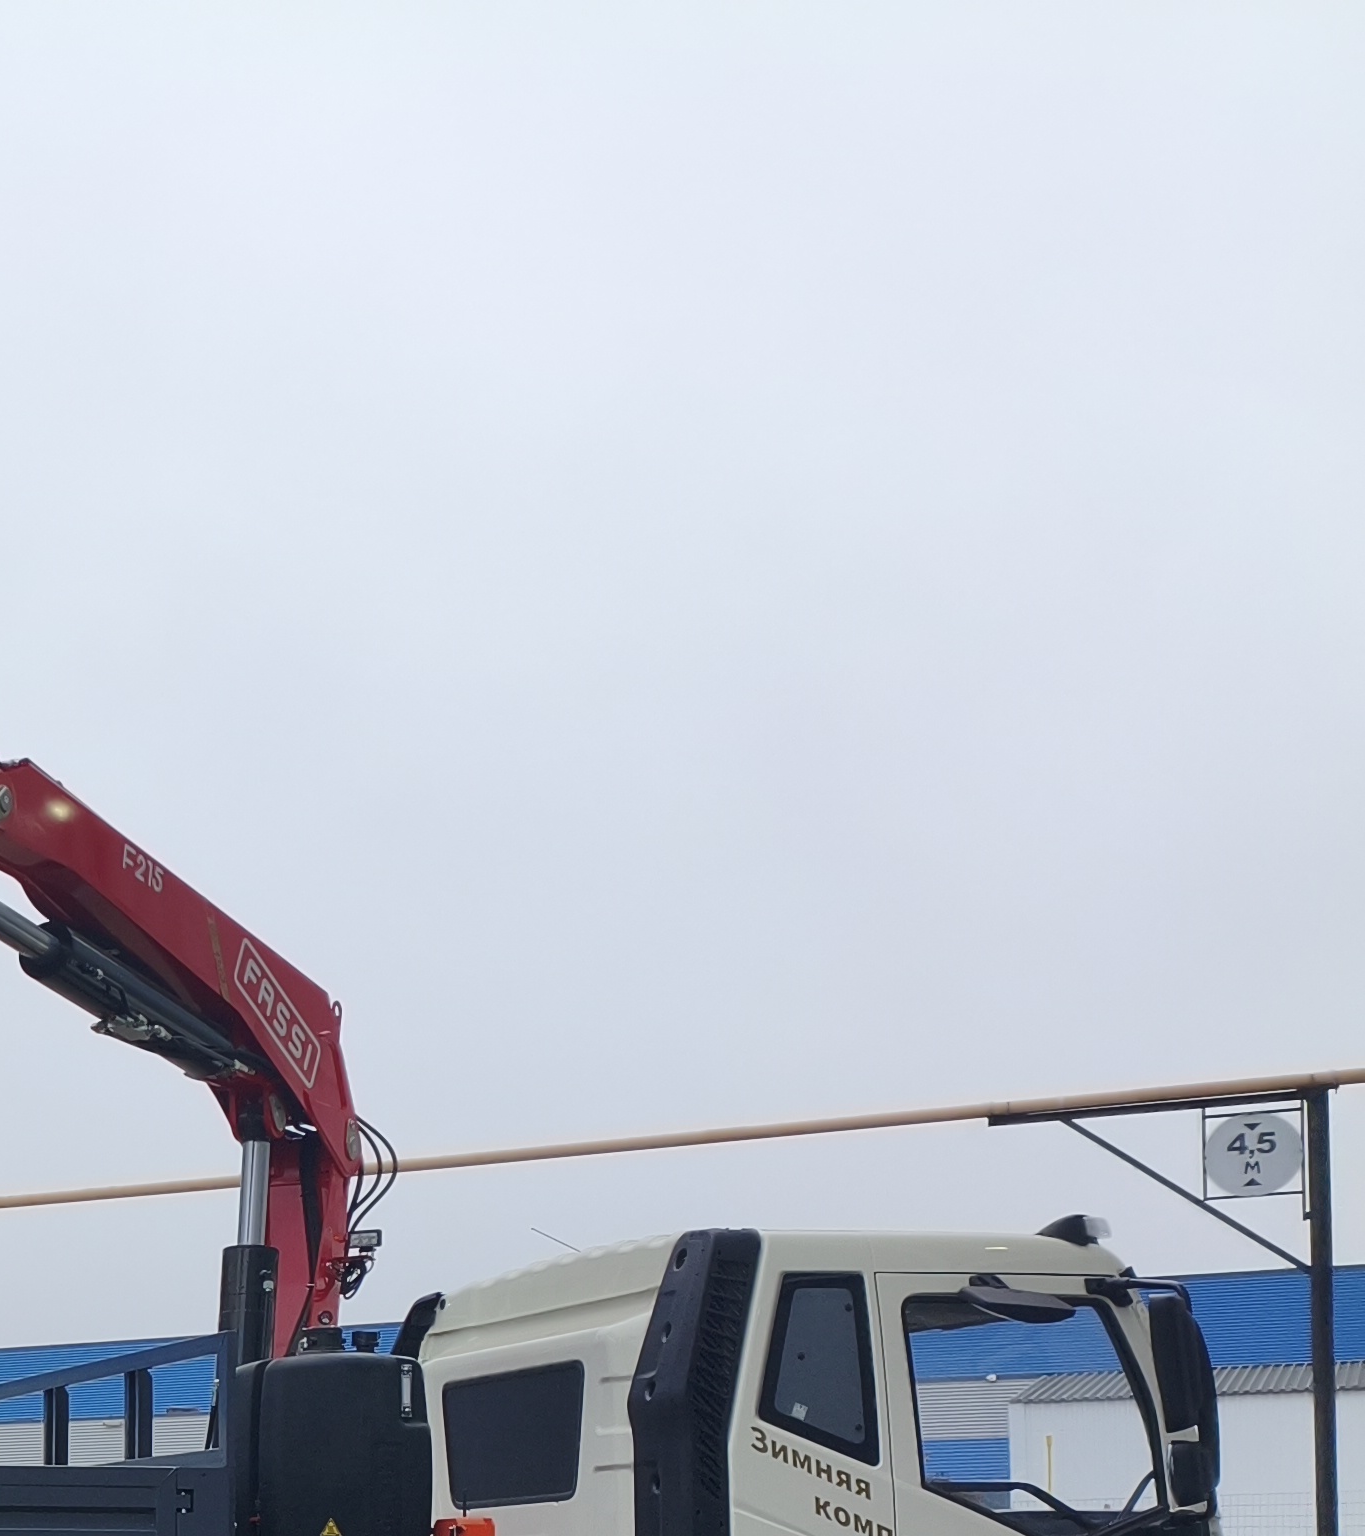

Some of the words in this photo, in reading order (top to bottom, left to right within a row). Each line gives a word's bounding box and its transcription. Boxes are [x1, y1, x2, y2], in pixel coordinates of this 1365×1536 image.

[122, 843, 165, 893] F215
[243, 958, 313, 1071] FASSI
[1226, 1131, 1277, 1159] 4,5
[750, 1426, 872, 1500] Зимняя
